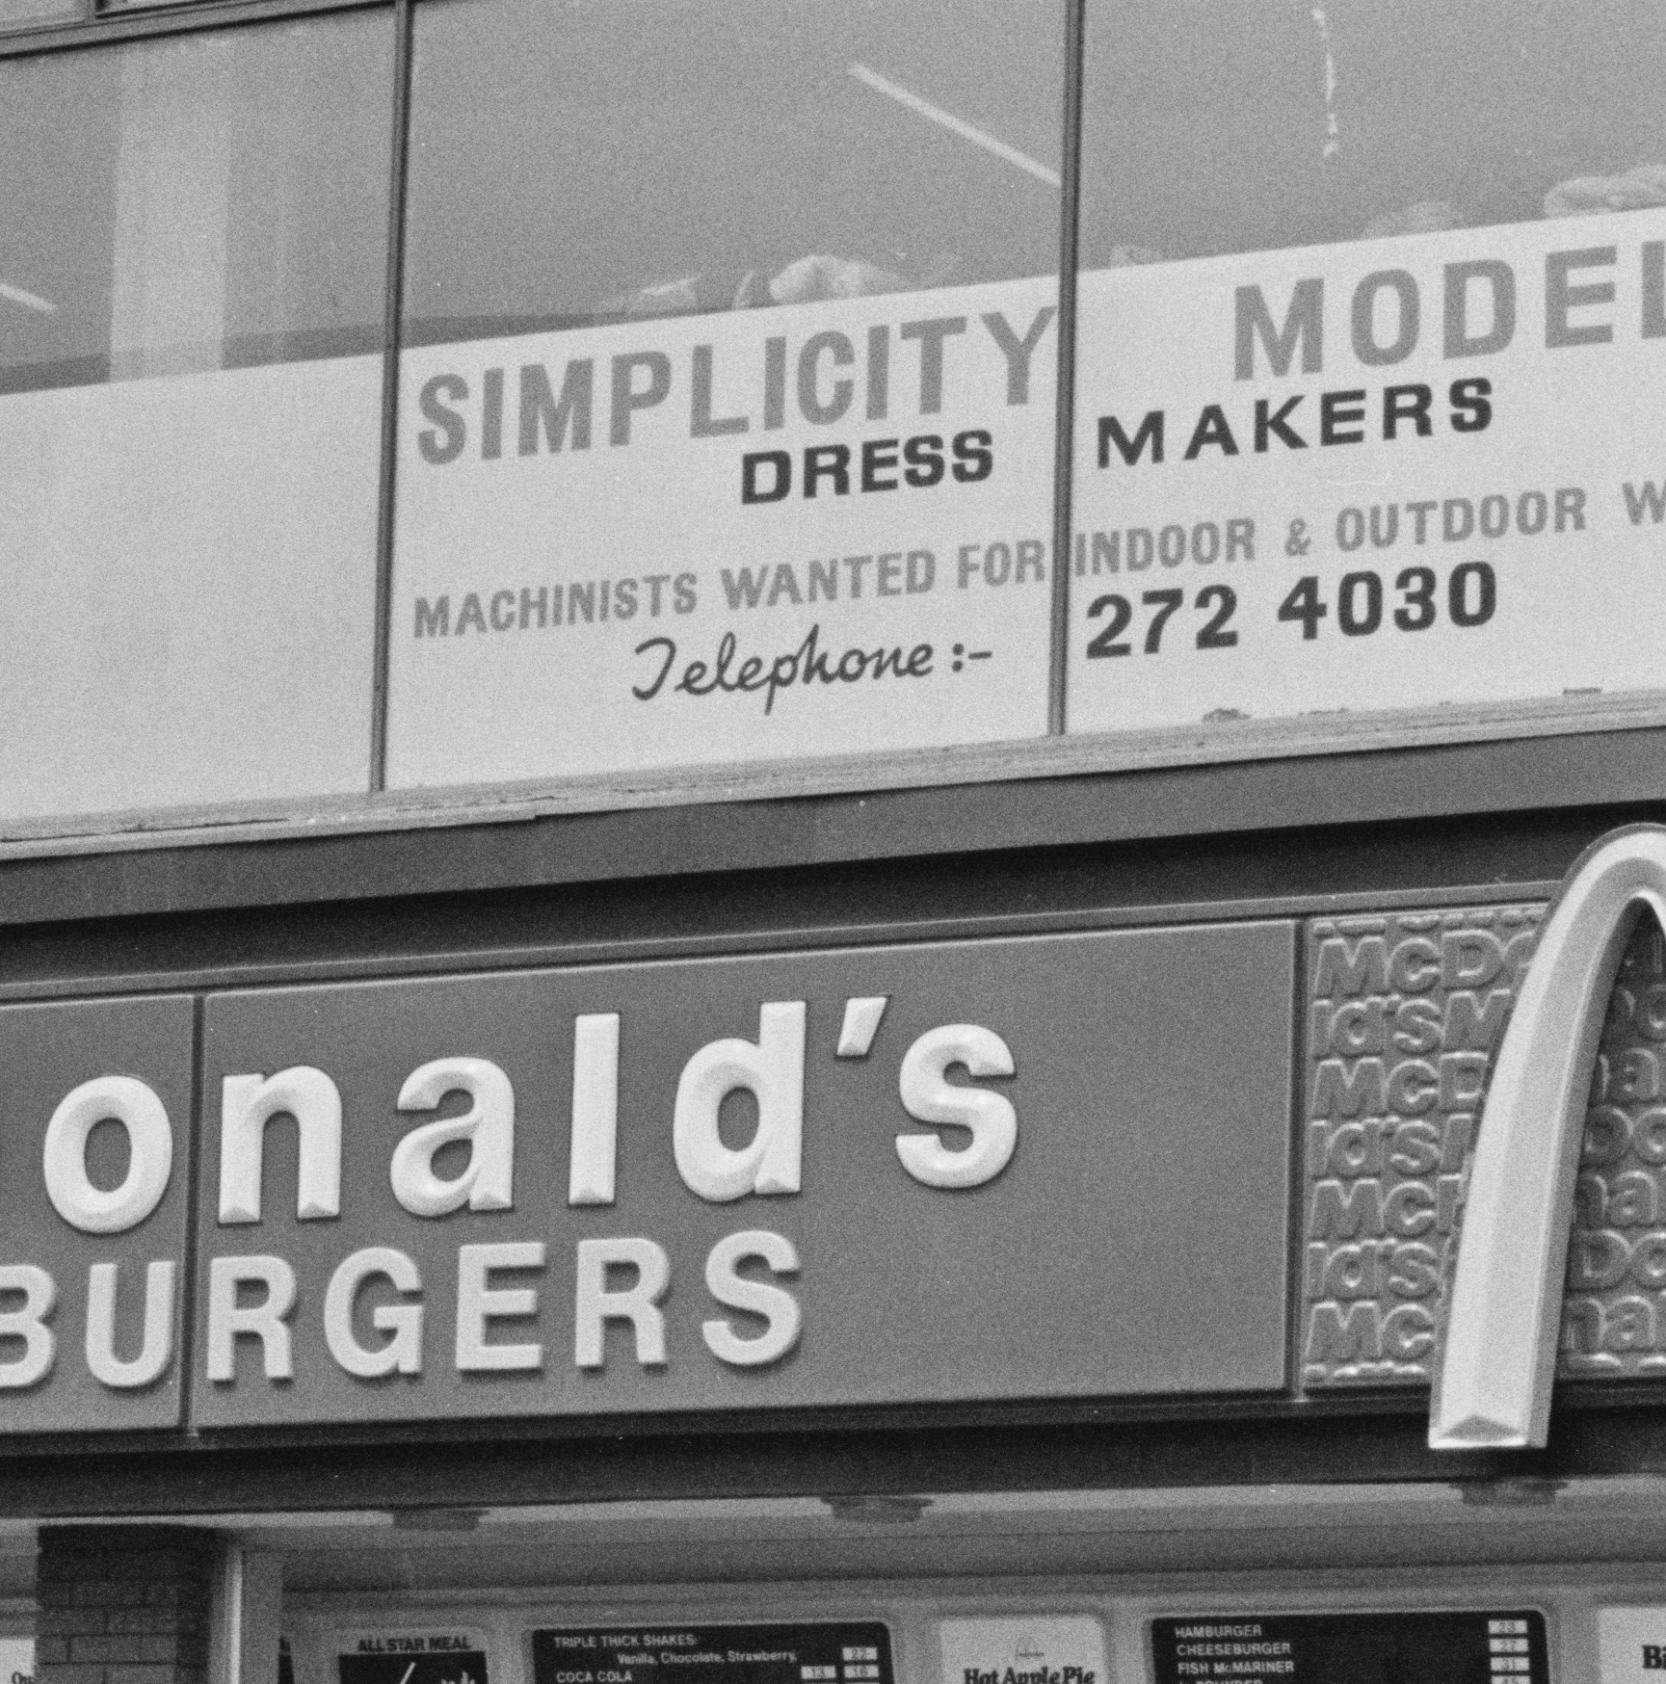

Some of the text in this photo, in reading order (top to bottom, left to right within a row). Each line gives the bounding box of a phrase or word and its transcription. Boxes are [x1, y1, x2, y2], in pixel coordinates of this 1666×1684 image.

[416, 306, 1058, 466] SIMPLICITY
[741, 377, 1492, 504] DRESS MAKERS
[413, 572, 698, 638] MACHINISTS
[722, 549, 935, 611] WANTED
[957, 539, 1047, 589] FOR
[1075, 517, 1255, 577] INDOOR
[1285, 518, 1312, 556] &
[1336, 486, 1587, 552] OUTDOOR
[1086, 583, 1238, 659] 272
[1278, 561, 1497, 641] 4030
[1175, 1625, 1262, 1638] HAMBURGER
[388, 1637, 424, 1651] STAR
[429, 1635, 471, 1650] MEAL
[554, 1636, 596, 1648] TRIPLE
[601, 1635, 639, 1647] THICK
[1177, 1642, 1291, 1656] CHEESEBURGER
[1178, 1661, 1209, 1674] FISH
[557, 1670, 594, 1684] COCA
[597, 1670, 632, 1683] COLA
